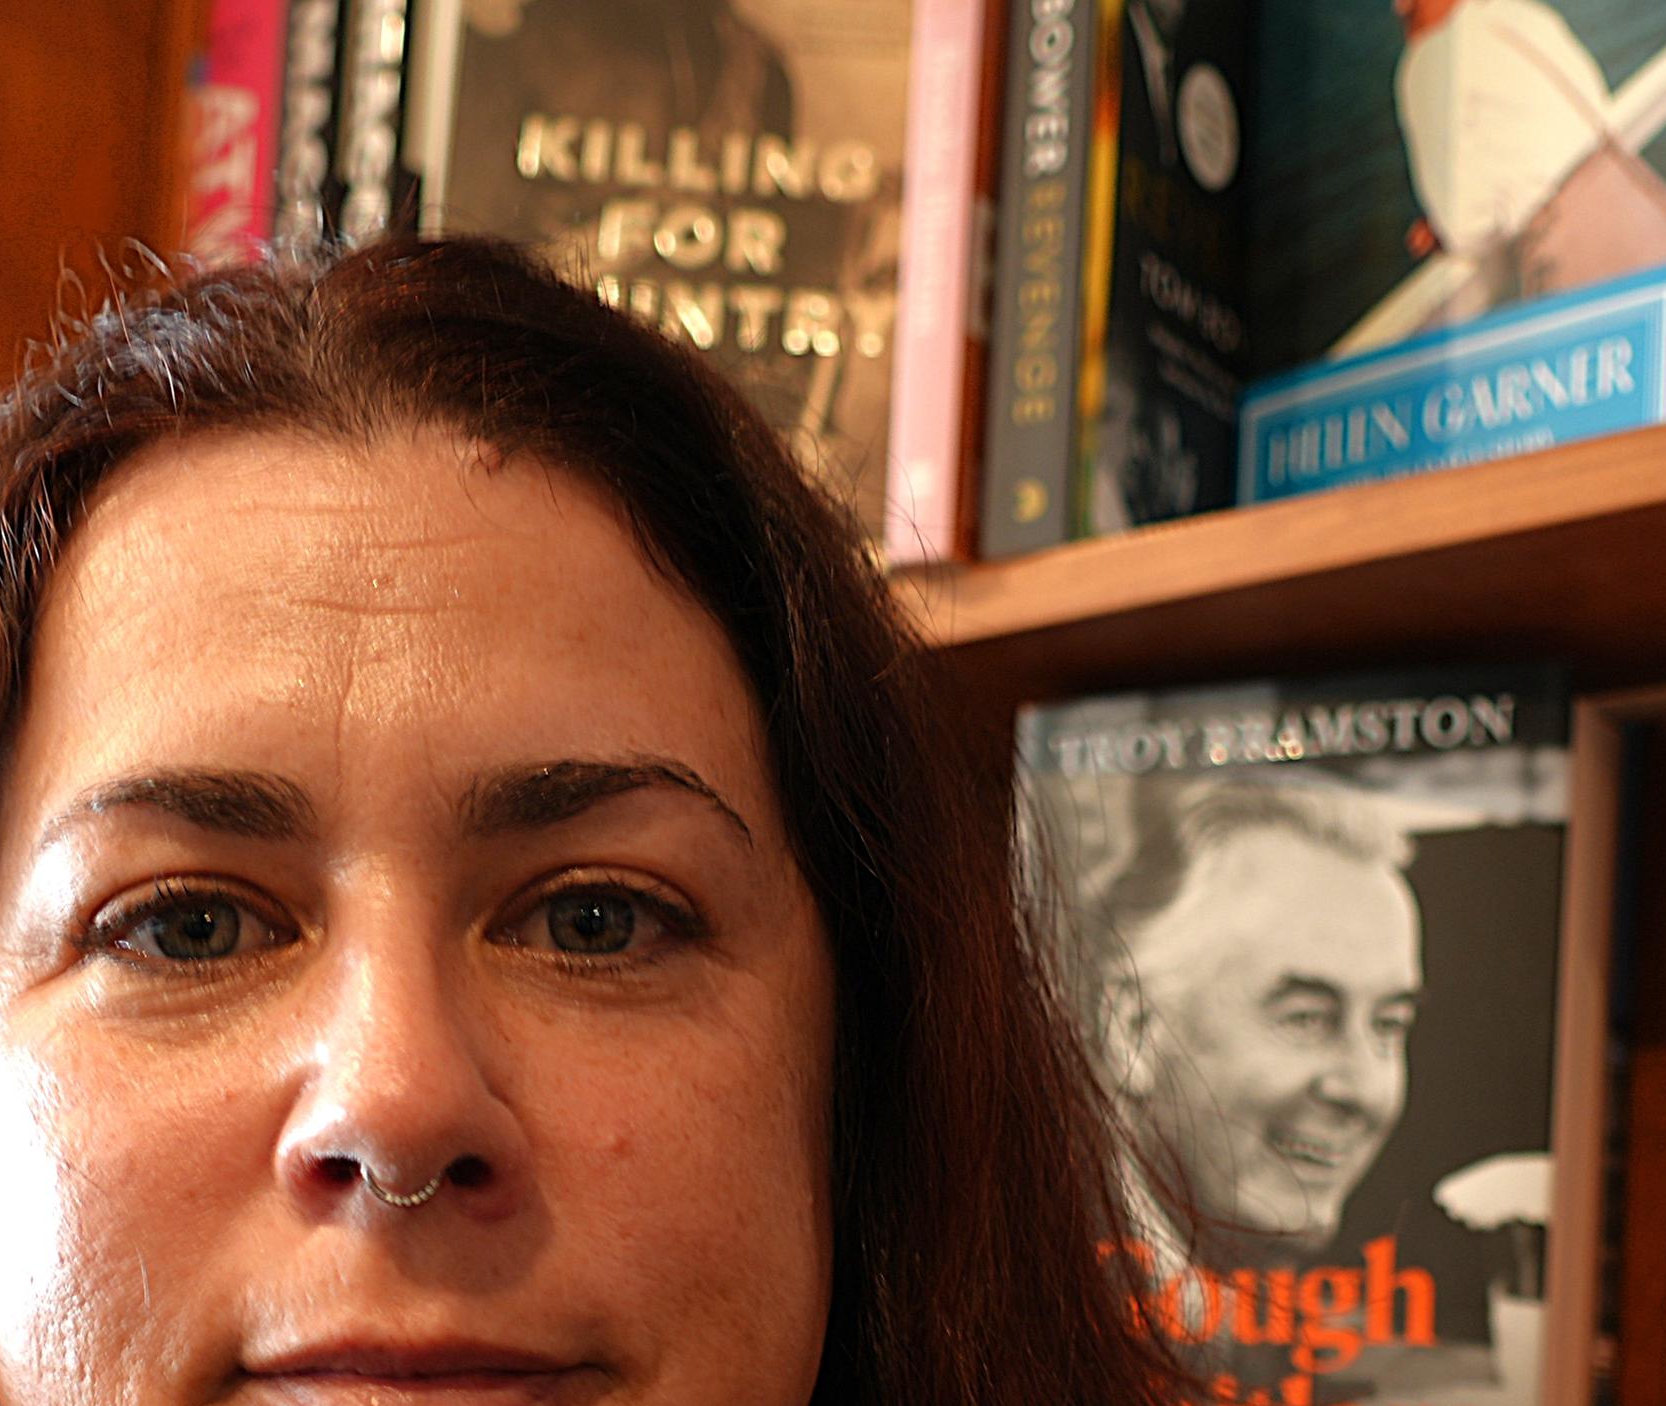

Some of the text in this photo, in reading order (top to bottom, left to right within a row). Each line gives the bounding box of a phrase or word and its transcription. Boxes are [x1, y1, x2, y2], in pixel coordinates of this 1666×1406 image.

[516, 113, 882, 203] KILLING
[597, 203, 789, 276] FOR
[1422, 334, 1636, 440] GARNER
[1048, 692, 1517, 779] TROY BRAMSTON
[1096, 1233, 1438, 1373] ough
